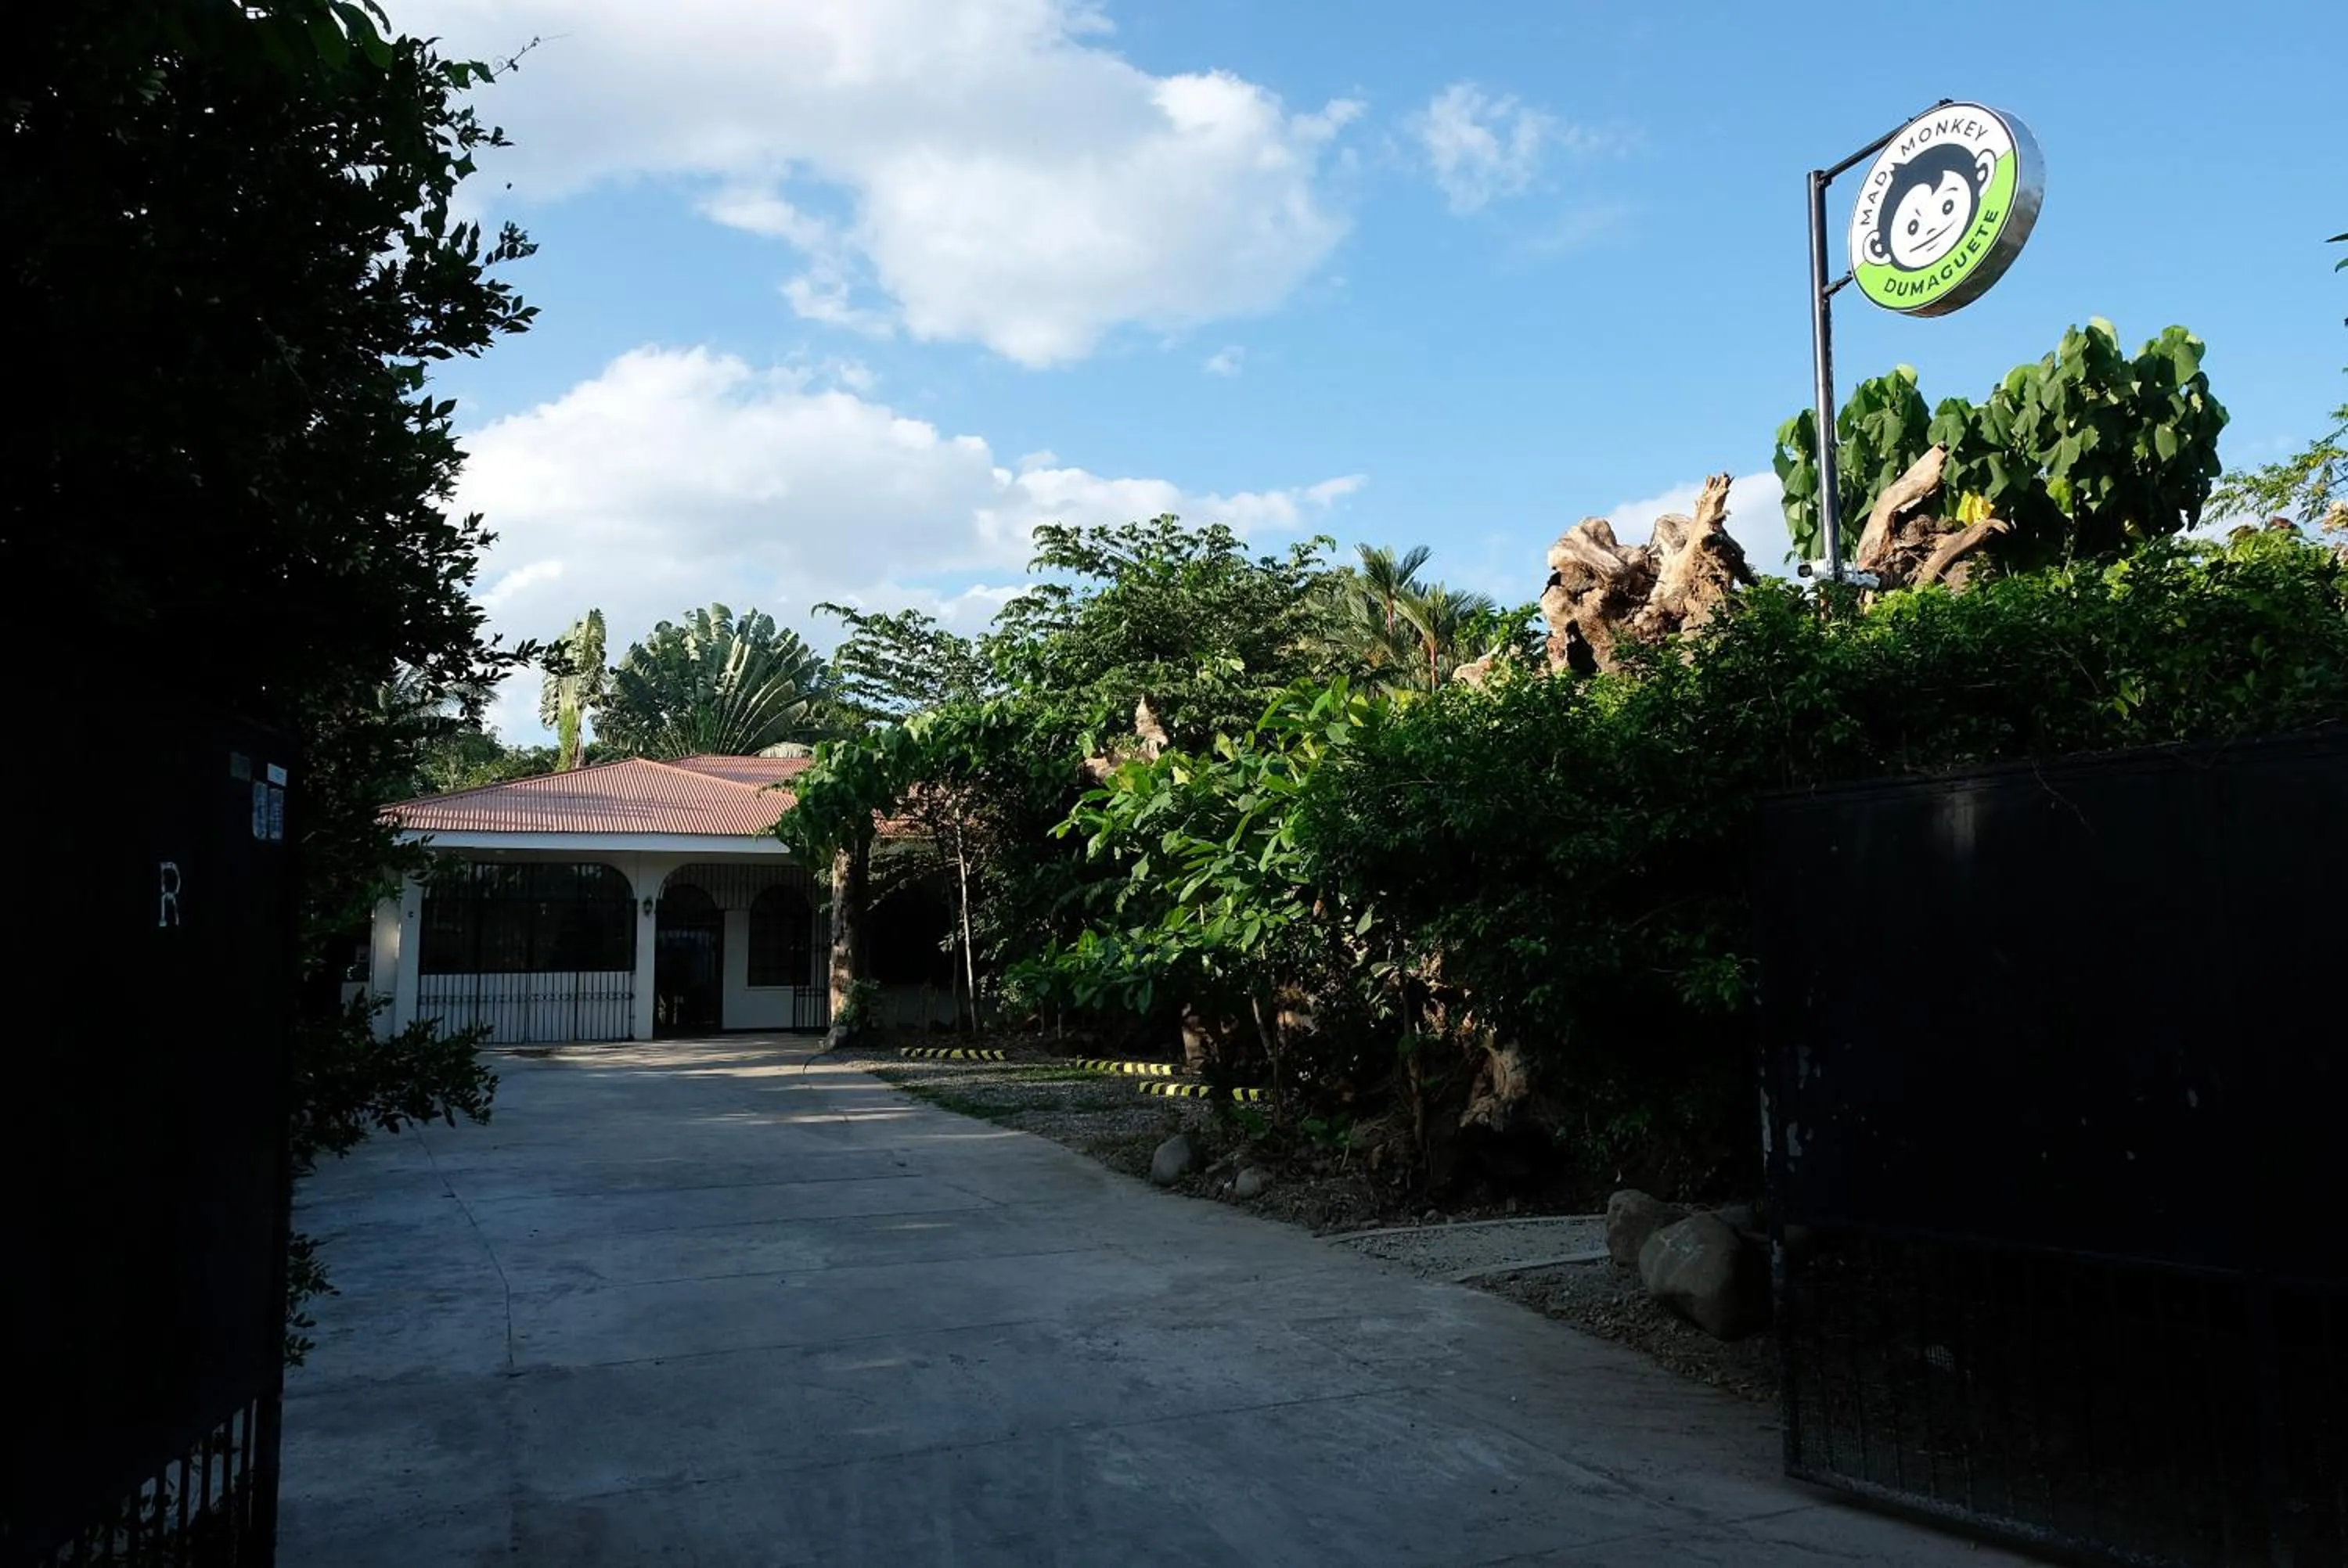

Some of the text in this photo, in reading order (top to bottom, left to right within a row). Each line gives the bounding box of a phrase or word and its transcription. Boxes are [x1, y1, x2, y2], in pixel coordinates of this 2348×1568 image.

[1860, 118, 1988, 225] MAD MONKEY
[1884, 209, 1999, 297] DUMAGUETE
